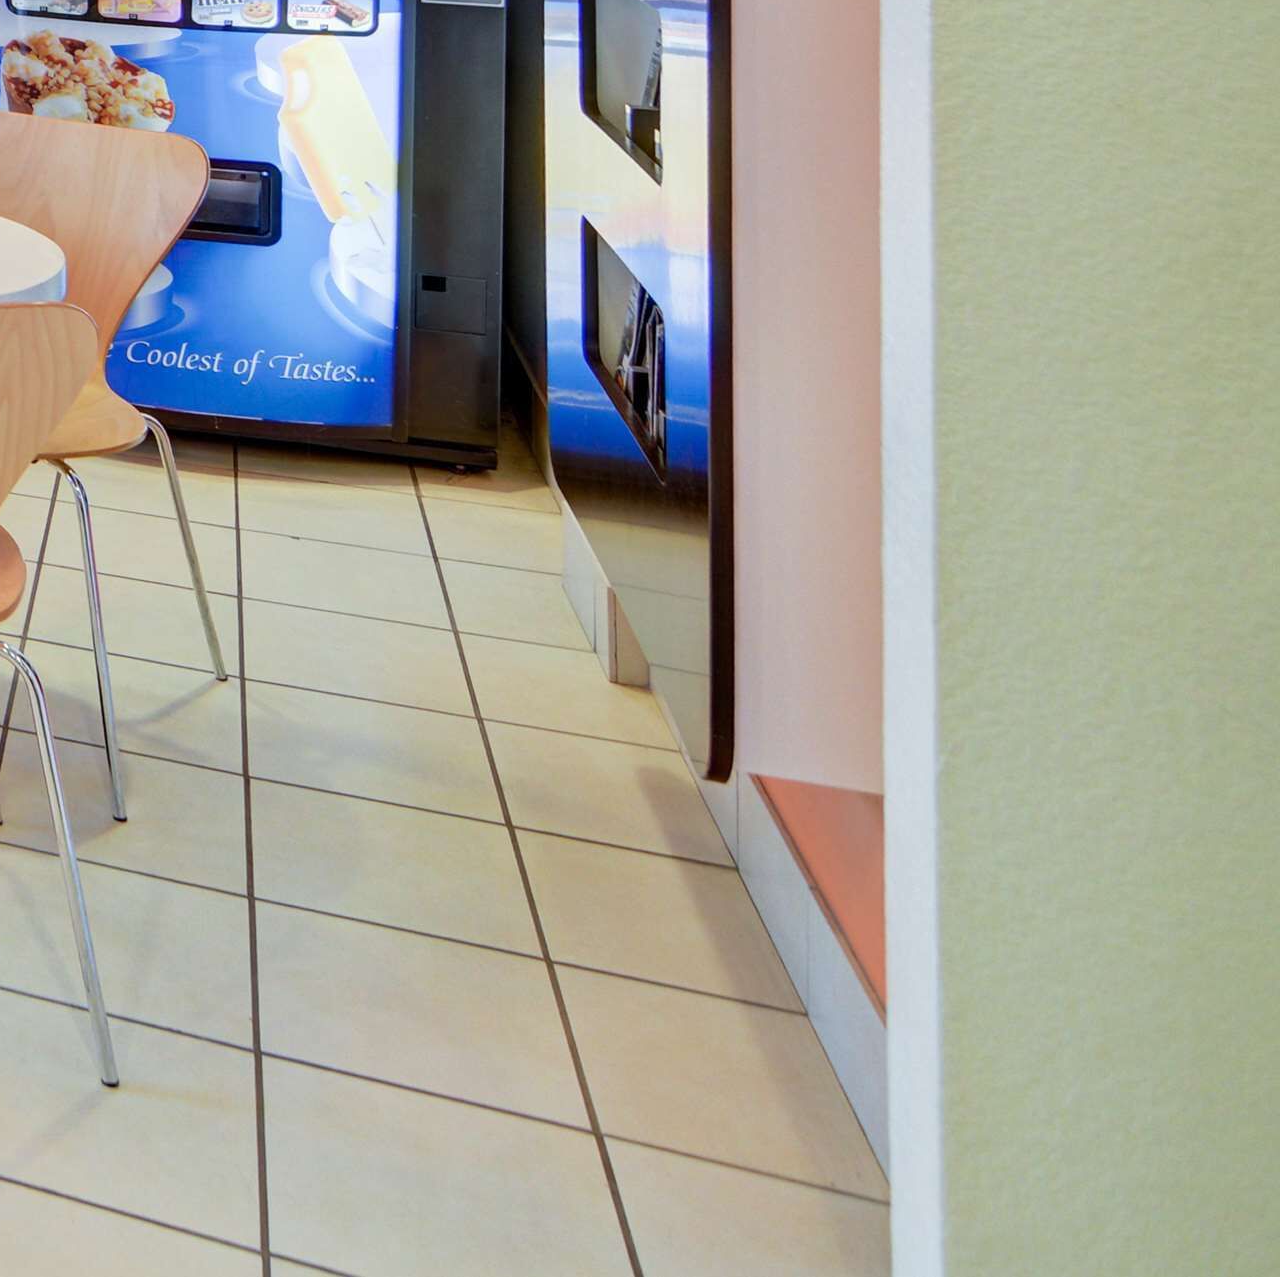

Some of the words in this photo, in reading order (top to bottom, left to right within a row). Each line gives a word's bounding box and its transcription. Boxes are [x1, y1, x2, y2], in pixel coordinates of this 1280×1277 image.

[126, 340, 224, 373] Coolest
[233, 350, 265, 385] of
[269, 352, 376, 383] Tastes...
